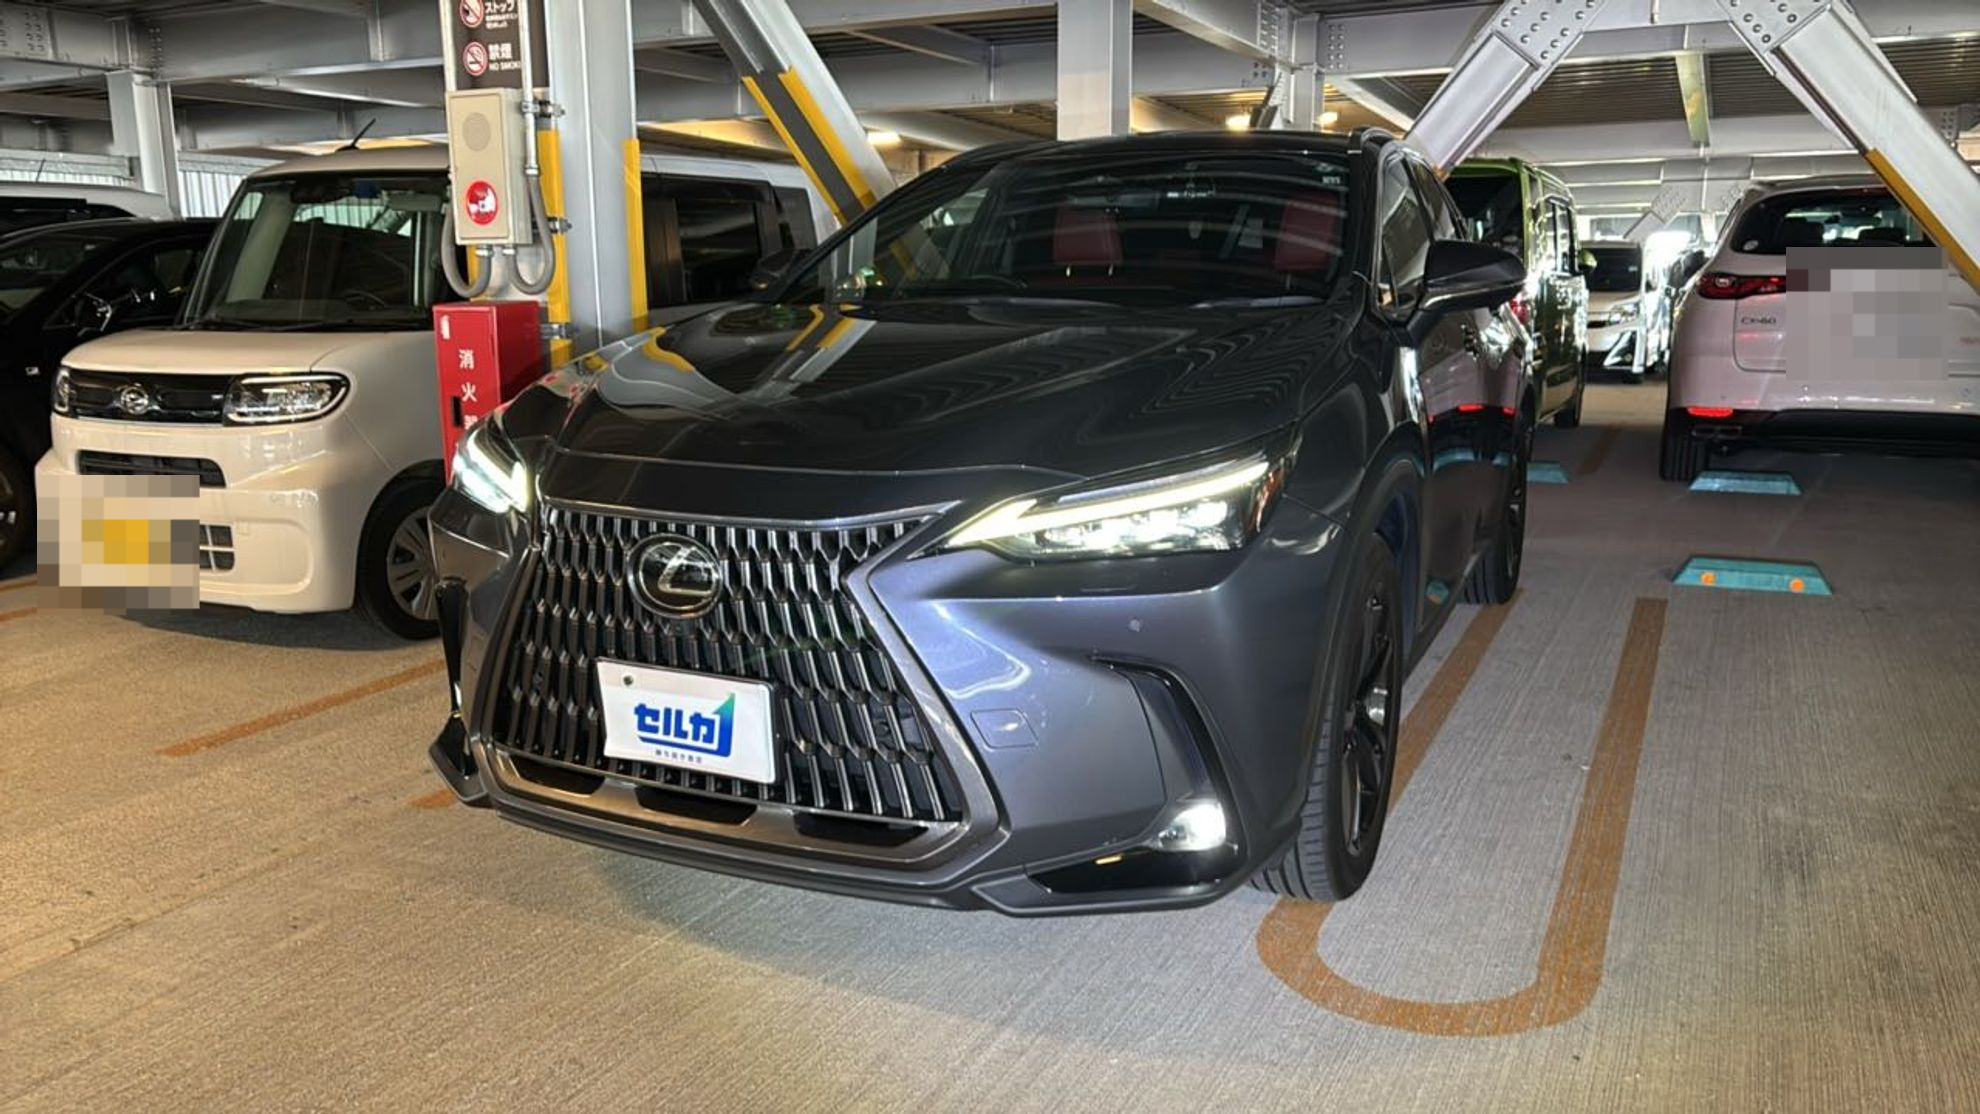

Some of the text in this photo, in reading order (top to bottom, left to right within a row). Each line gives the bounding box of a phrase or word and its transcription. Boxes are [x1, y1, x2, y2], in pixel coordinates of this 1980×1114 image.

[489, 62, 499, 71] NO
[634, 703, 717, 745] セルカ
